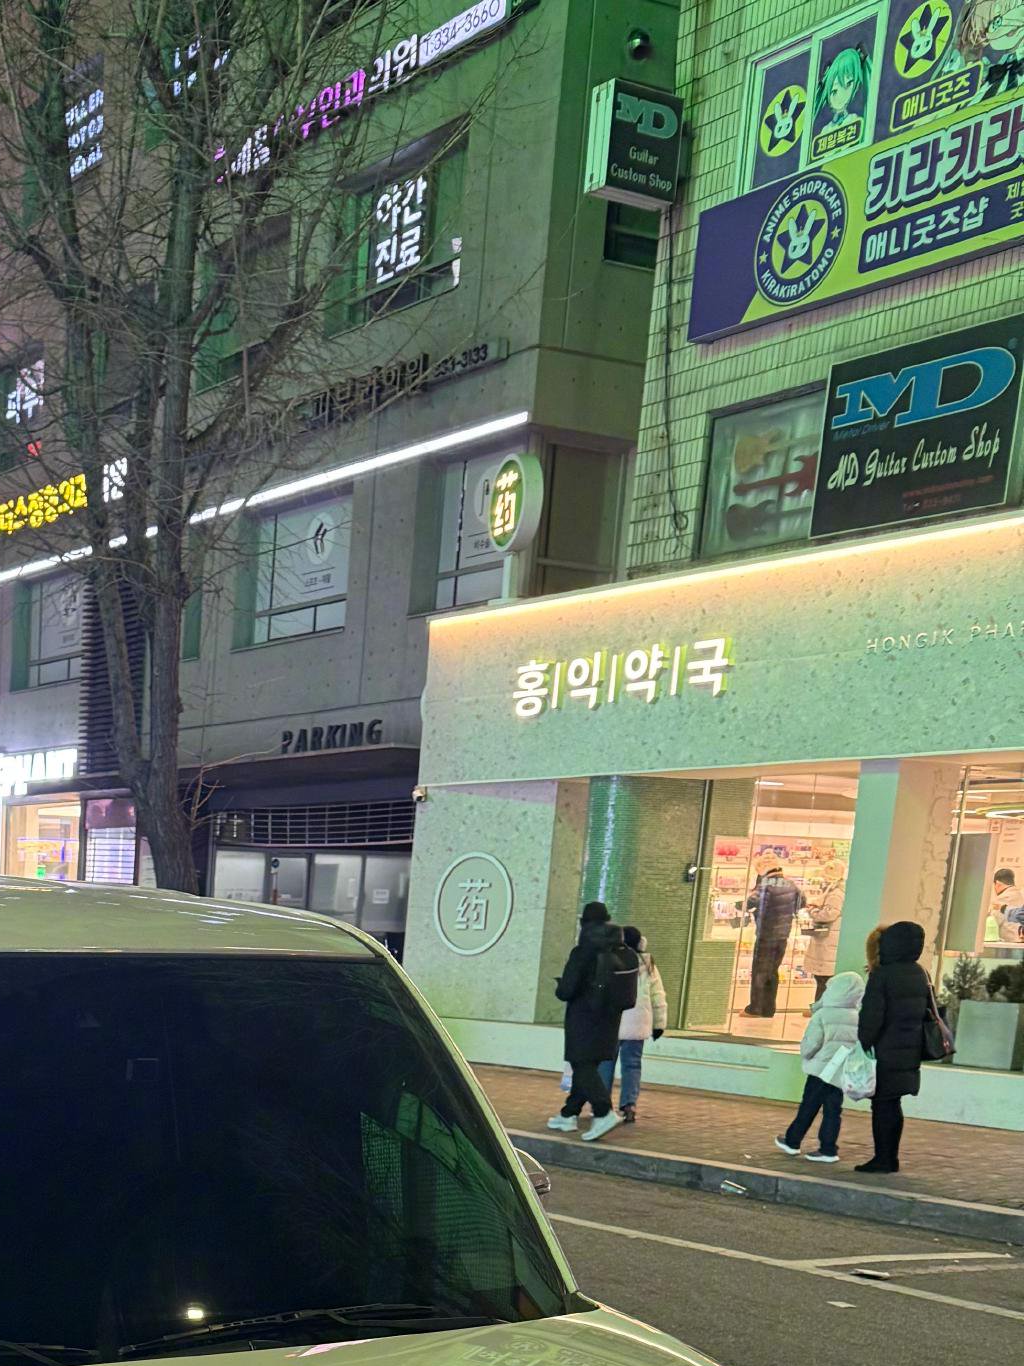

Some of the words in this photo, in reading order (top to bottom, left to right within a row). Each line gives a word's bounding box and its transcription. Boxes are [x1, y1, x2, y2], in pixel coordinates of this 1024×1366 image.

[616, 92, 678, 139] MD
[902, 72, 971, 120] 애니굿즈
[610, 163, 646, 185] Custom
[649, 173, 673, 192] Shop
[629, 145, 659, 166] Guitar
[868, 100, 1024, 211] 키라키라
[376, 174, 427, 232] 야간
[763, 195, 791, 243] ANIME
[792, 180, 842, 221] SHOP&CAFE
[1005, 181, 1024, 201] 제
[375, 225, 421, 284] 진료
[865, 196, 990, 264] 애니굿즈샵
[831, 346, 1016, 429] MD
[828, 452, 859, 490] MD
[862, 448, 907, 487] Guitar
[911, 438, 957, 472] Custom
[962, 422, 1000, 468] Shop
[865, 628, 955, 654] HONGIK
[280, 718, 383, 754] PARKING
